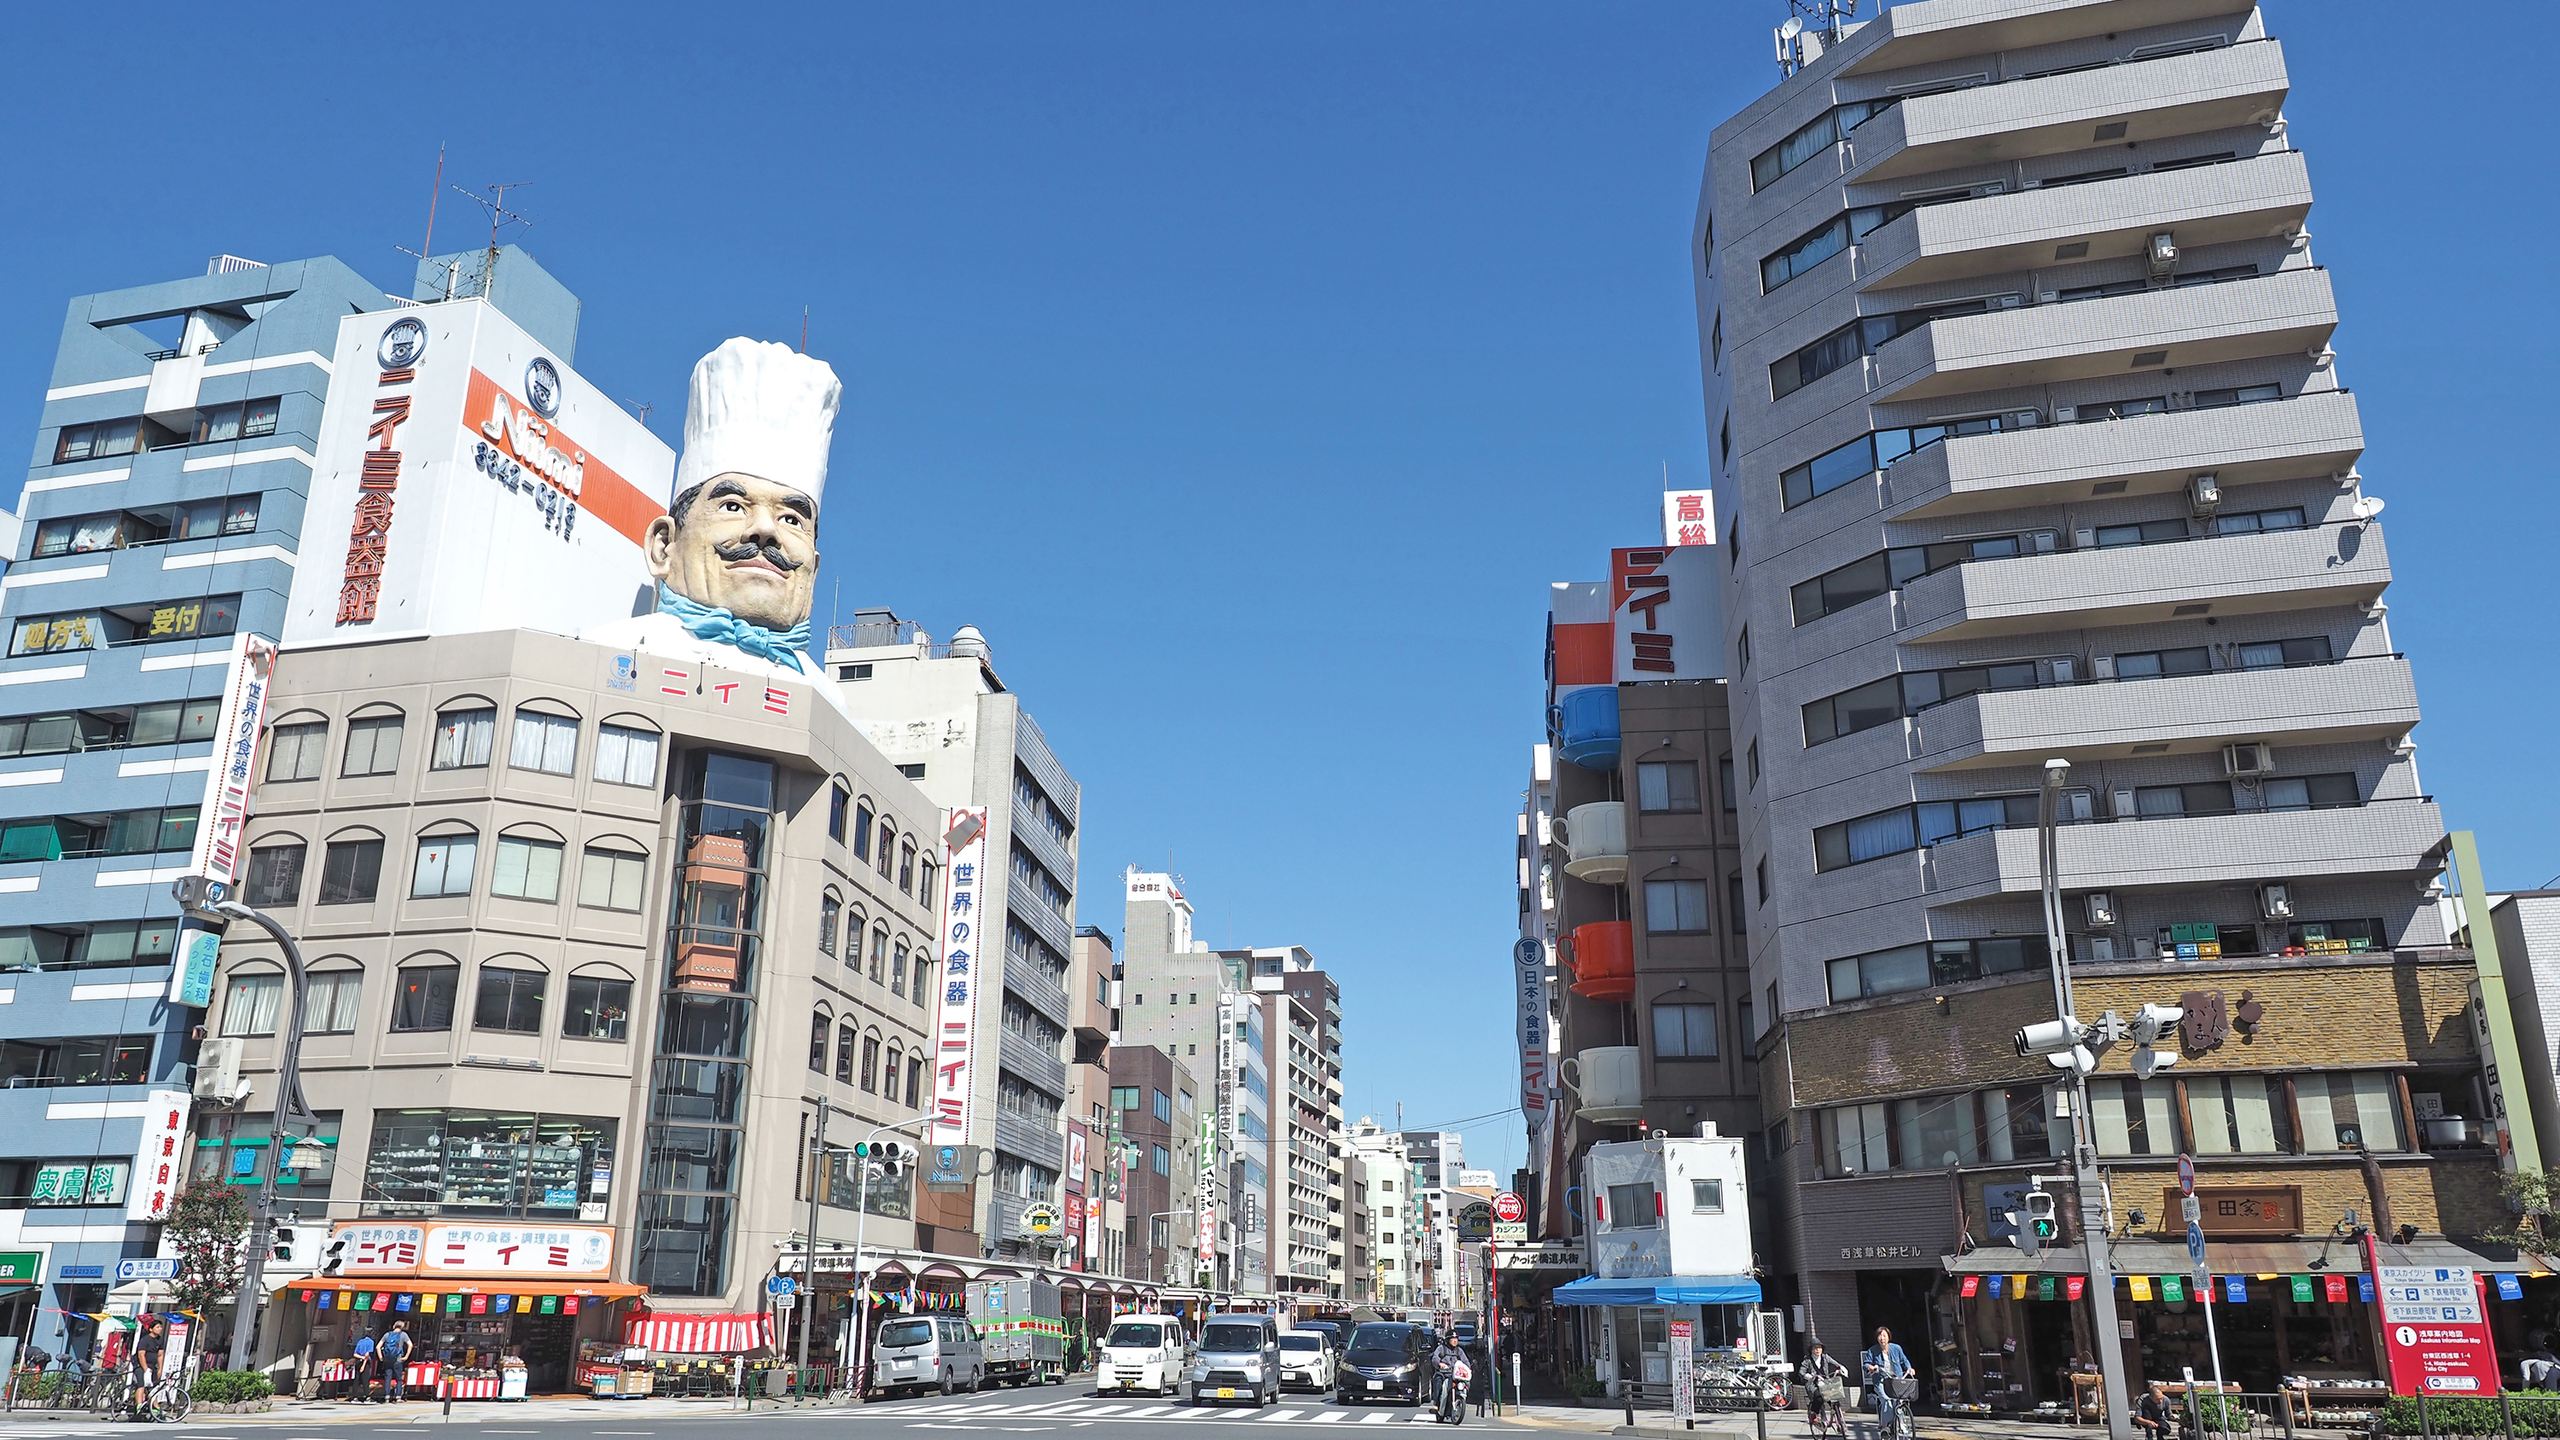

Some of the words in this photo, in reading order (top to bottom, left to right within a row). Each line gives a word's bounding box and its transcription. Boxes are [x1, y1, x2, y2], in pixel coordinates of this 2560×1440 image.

[480, 393, 585, 496] Niimi
[337, 368, 415, 622] ニイミ食器館
[151, 604, 200, 635] 受付
[1626, 551, 1674, 673] ニイミ
[24, 617, 93, 649] 処方せん
[661, 670, 790, 715] ニイミ
[231, 681, 262, 779] 世界の食器
[213, 786, 243, 868] ニイミ
[948, 863, 974, 1001] 世界の食器
[185, 950, 199, 999] クリニック
[195, 937, 215, 1002] 永石歯科
[1524, 971, 1540, 1045] 日本の食器
[939, 1023, 966, 1126] ニイミ
[1525, 1050, 1545, 1110] ニイミ
[152, 1109, 180, 1213] 東京白衣
[32, 1166, 114, 1199] 皮膚科
[1499, 1203, 1519, 1214] 消火栓
[361, 1229, 418, 1241] 世界の食器
[447, 1231, 571, 1244] 世界の食器・調理器具
[137, 1261, 169, 1271] 浅草通り
[357, 1242, 416, 1264] ニイミ
[444, 1244, 569, 1267] ニイミ
[793, 1257, 855, 1268] か橋道具街
[1509, 1253, 1579, 1266] かっぱ橋道具街
[1841, 1246, 1921, 1259] 西浅草松井ビル
[0, 1265, 15, 1277] ER
[2384, 1269, 2431, 1277] 東京スカイツリー
